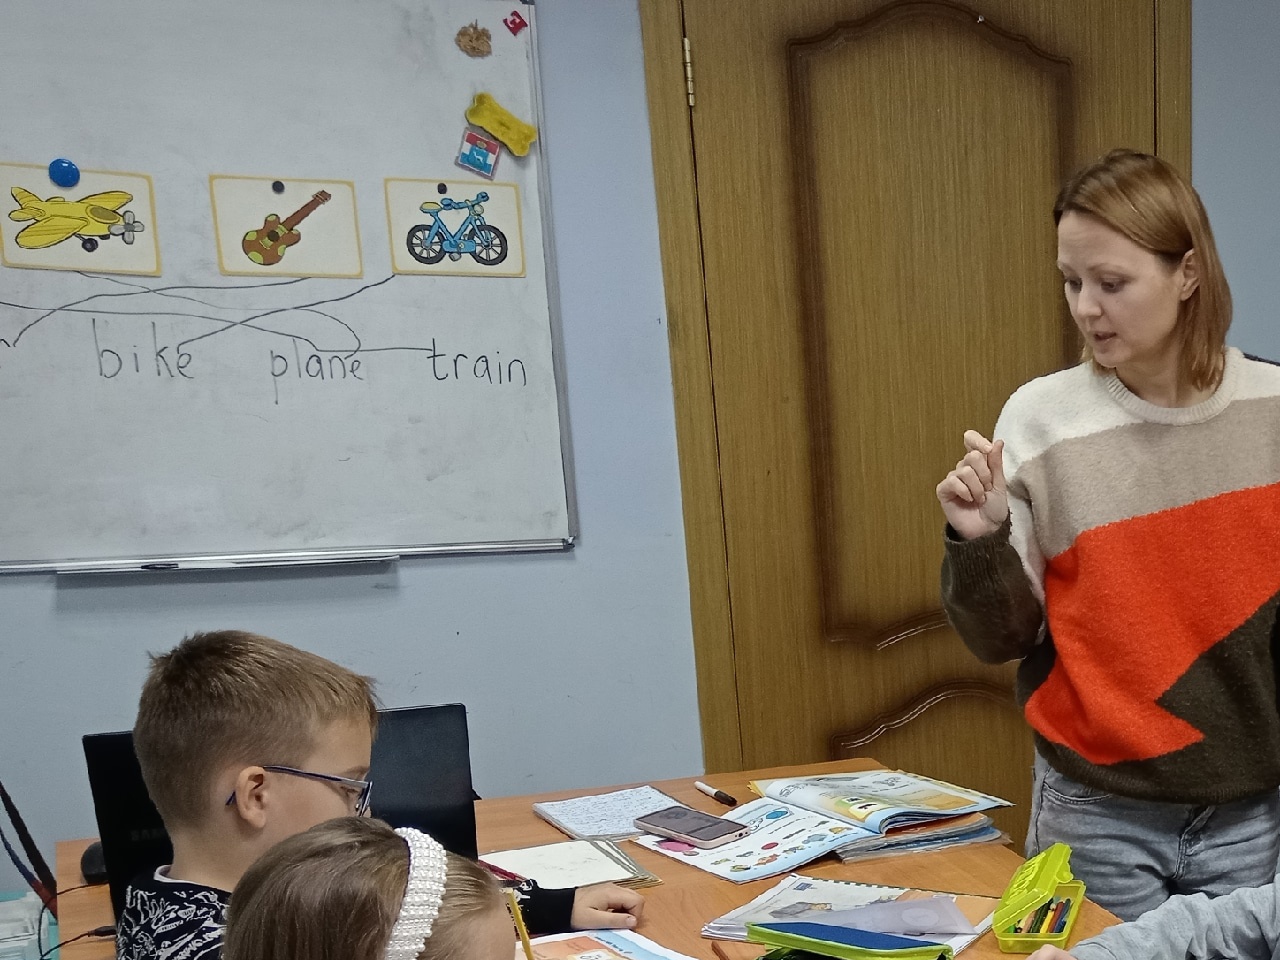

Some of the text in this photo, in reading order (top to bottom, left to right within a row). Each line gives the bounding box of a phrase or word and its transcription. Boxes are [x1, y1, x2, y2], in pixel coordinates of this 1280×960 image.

[91, 318, 528, 404] bike plane train
